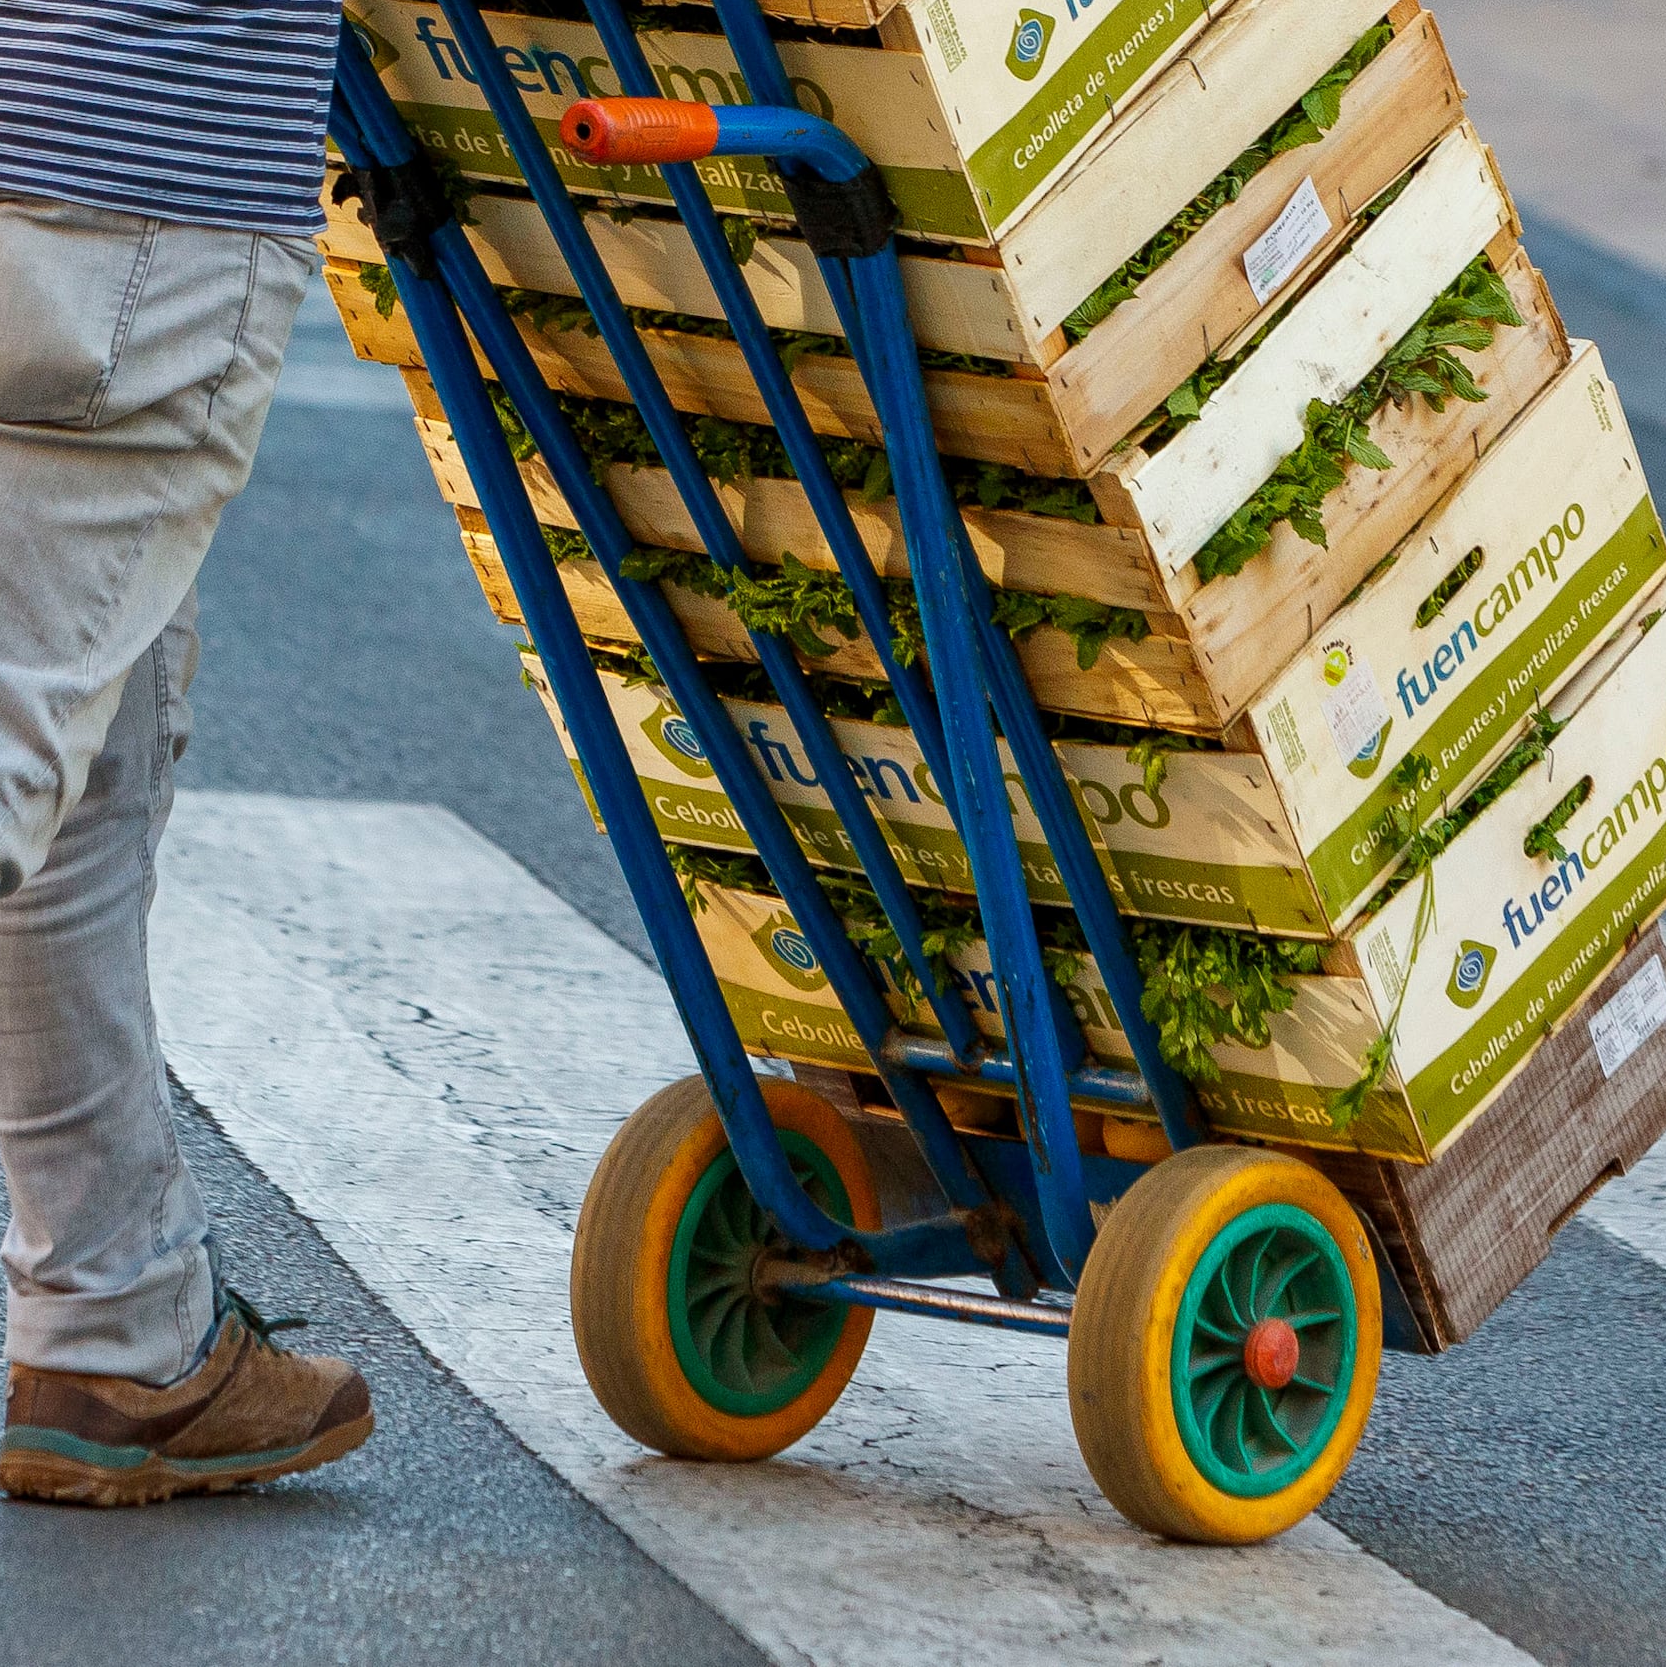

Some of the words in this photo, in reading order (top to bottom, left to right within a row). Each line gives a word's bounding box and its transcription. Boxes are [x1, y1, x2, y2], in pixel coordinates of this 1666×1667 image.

[1013, 93, 1084, 170] Cebolleta
[1084, 70, 1106, 97] de
[1105, 8, 1165, 74] Fuentes
[453, 127, 492, 155] de
[1396, 502, 1586, 720] fuencampo
[1350, 788, 1419, 866] Cebolta
[1440, 703, 1497, 769] Fuentes
[1497, 691, 1507, 715] y
[1507, 615, 1579, 697] hortalizas
[1579, 562, 1628, 620] frescas
[655, 795, 746, 832] Ceboll
[834, 829, 949, 869] Fntes
[1130, 870, 1235, 905] frescas
[762, 1010, 867, 1051] Cebolle
[1450, 1020, 1524, 1095] Cebolleta
[1525, 997, 1545, 1024] de
[1546, 936, 1601, 1001] Fuentes
[1601, 922, 1611, 948] y
[1231, 1089, 1334, 1127] frescas
